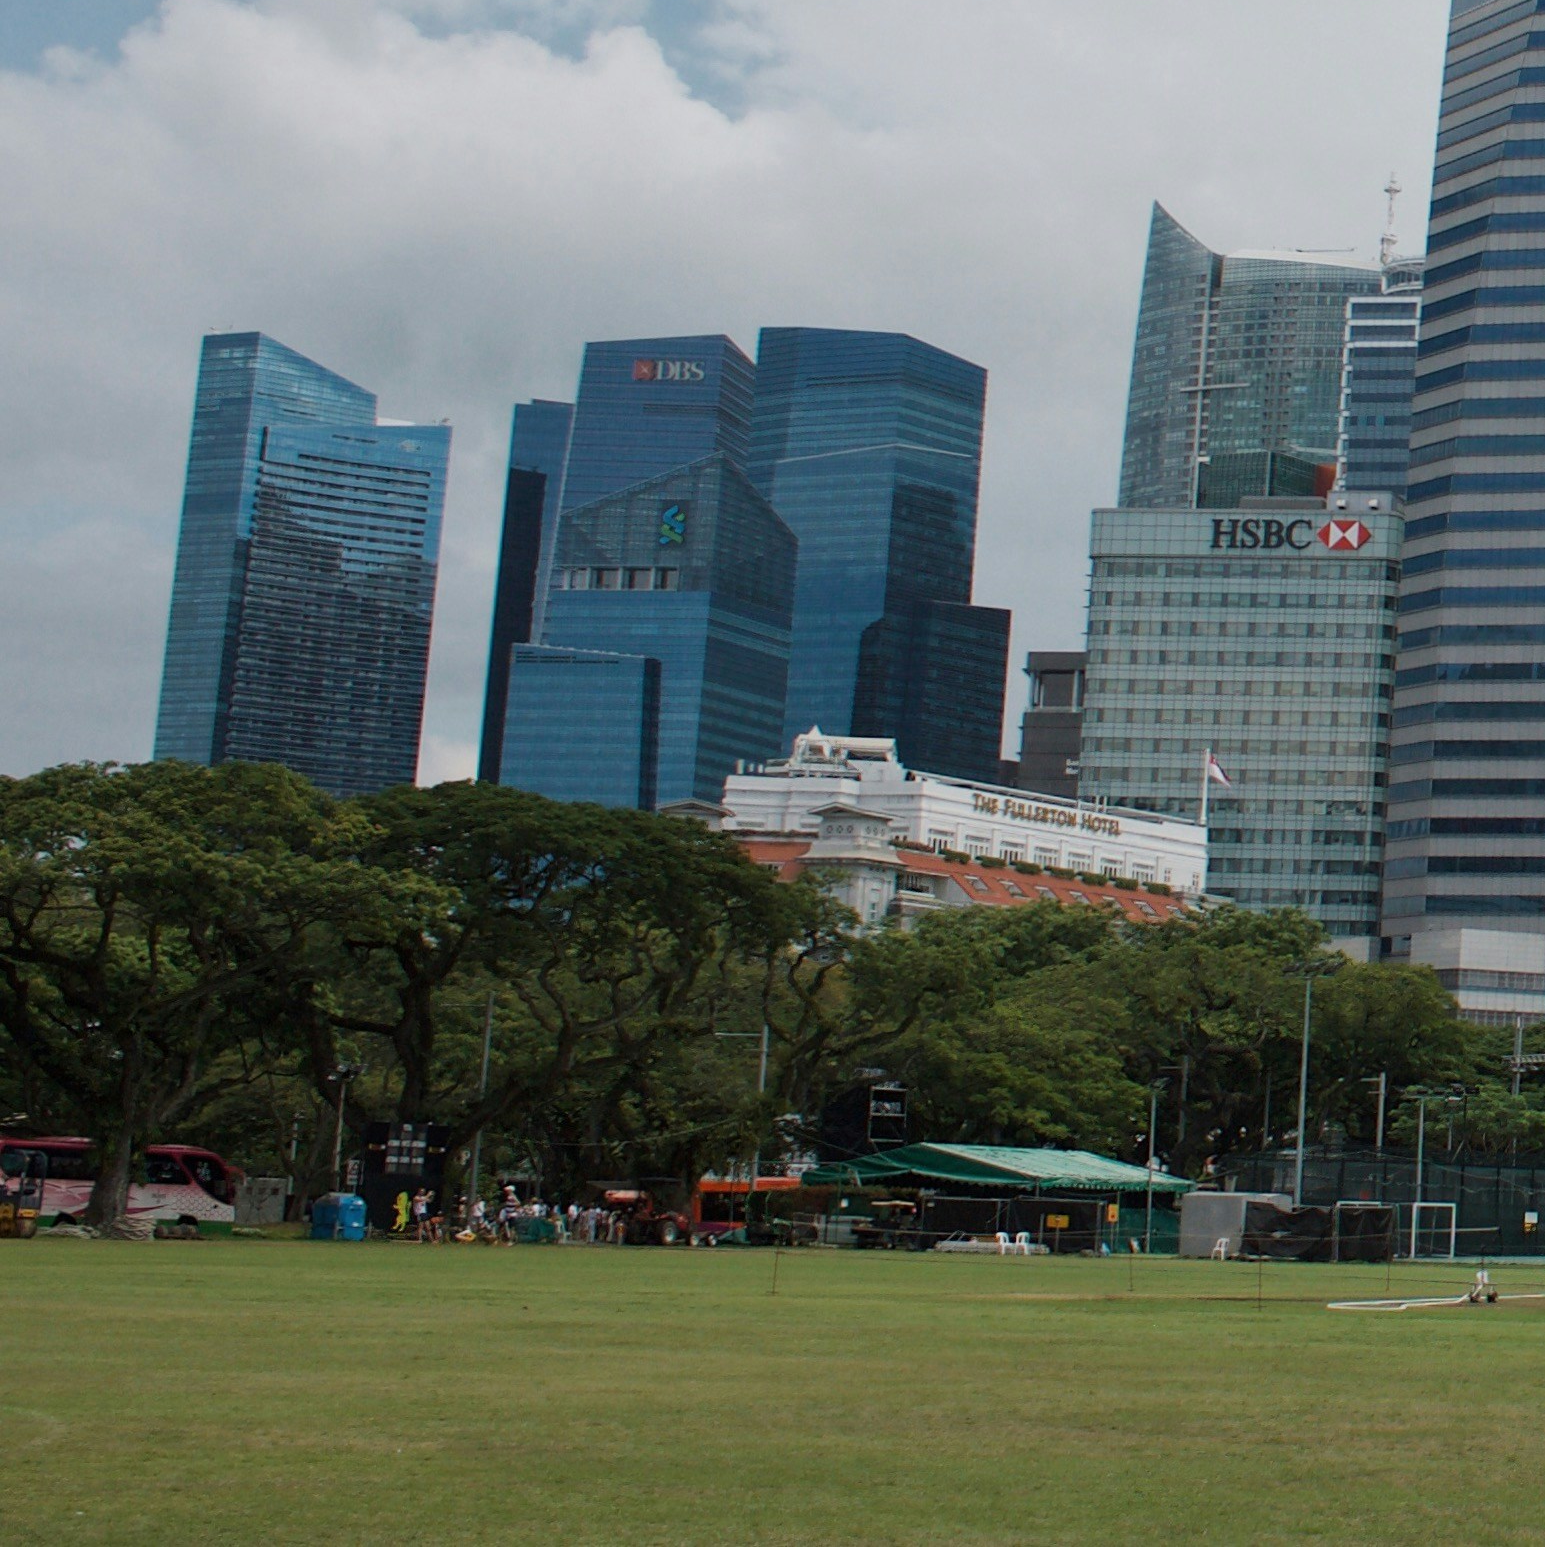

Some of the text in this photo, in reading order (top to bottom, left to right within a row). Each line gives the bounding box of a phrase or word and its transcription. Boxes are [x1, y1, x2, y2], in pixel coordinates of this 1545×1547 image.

[656, 359, 705, 381] DBS
[1210, 518, 1312, 550] HSBC
[973, 793, 1121, 836] THE FULLERTON HOTEL
